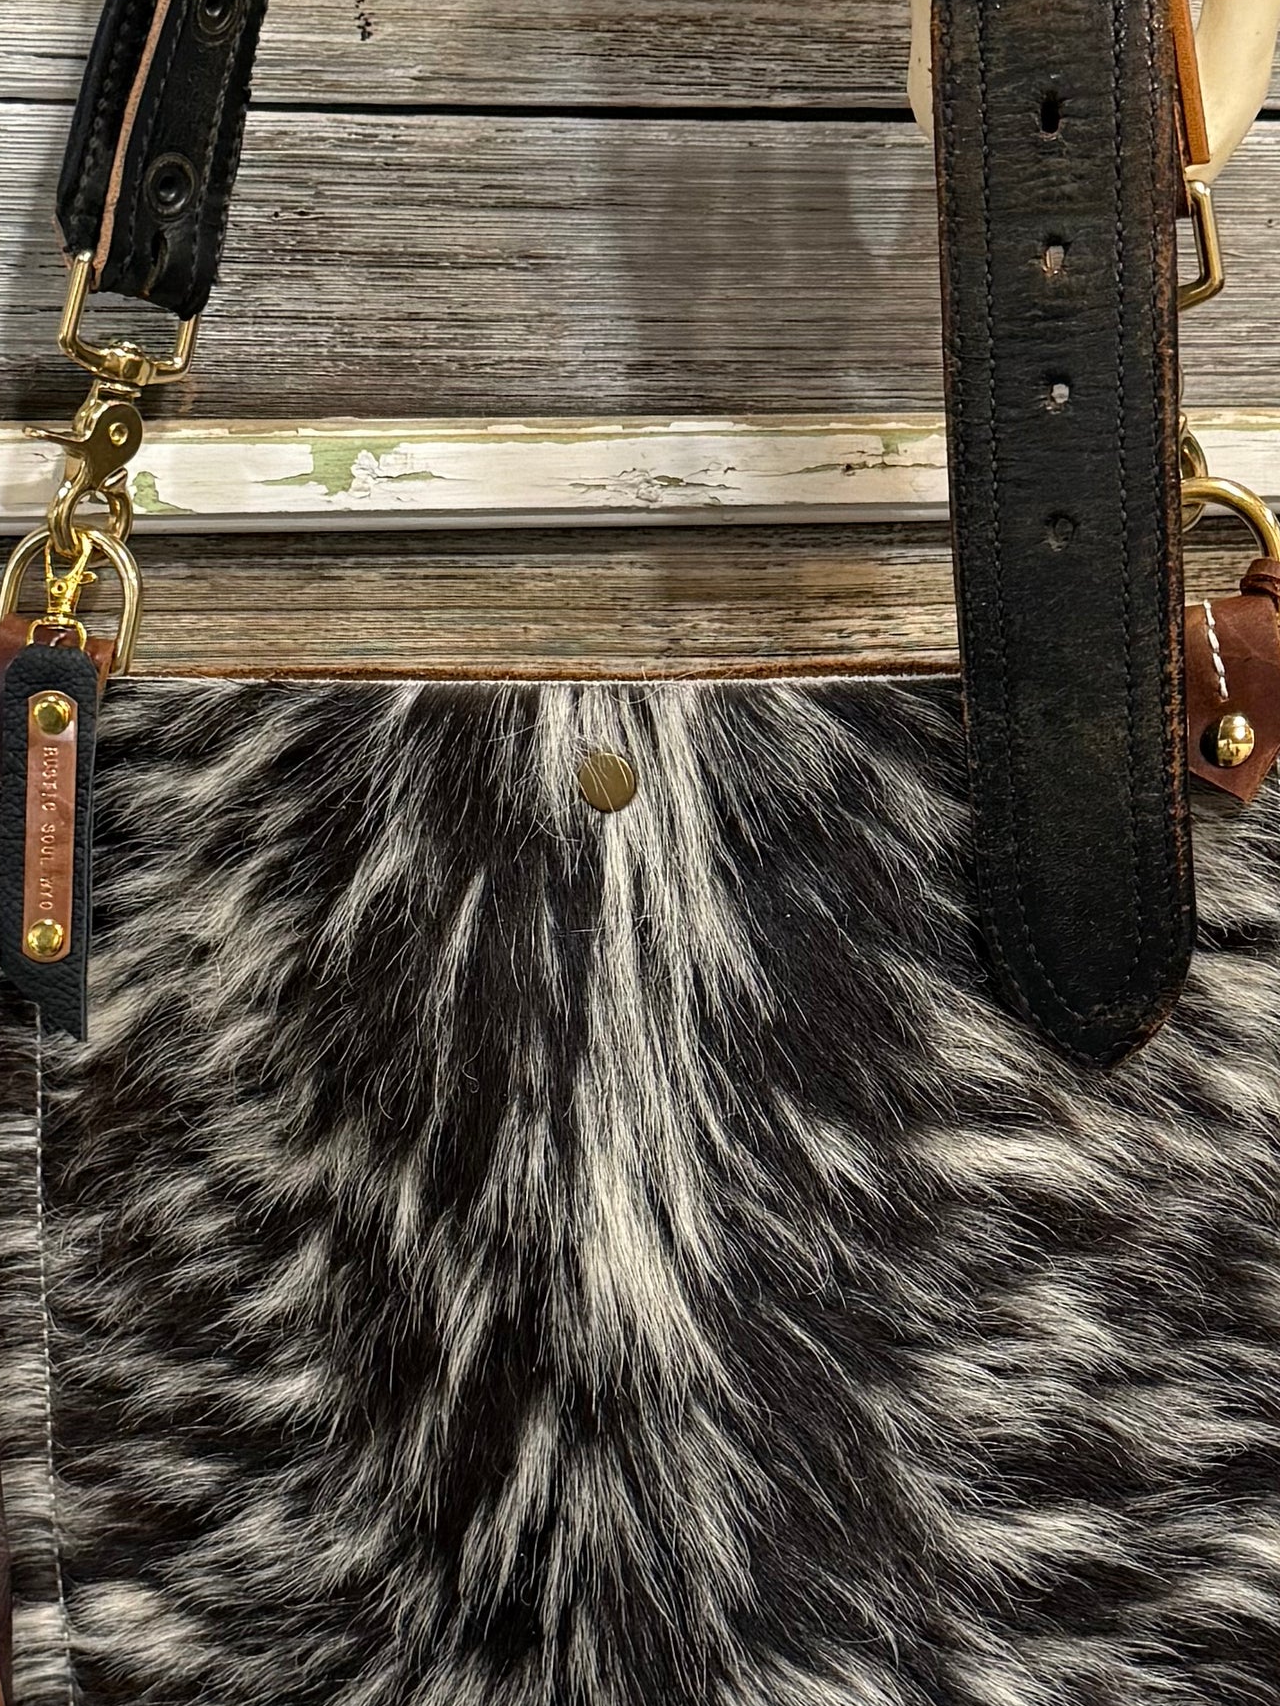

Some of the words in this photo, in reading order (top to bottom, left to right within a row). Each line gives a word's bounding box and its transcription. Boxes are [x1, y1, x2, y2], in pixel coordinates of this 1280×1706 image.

[41, 746, 58, 812] RUSTIC
[39, 823, 55, 865] SOUL
[39, 877, 53, 910] WYO
